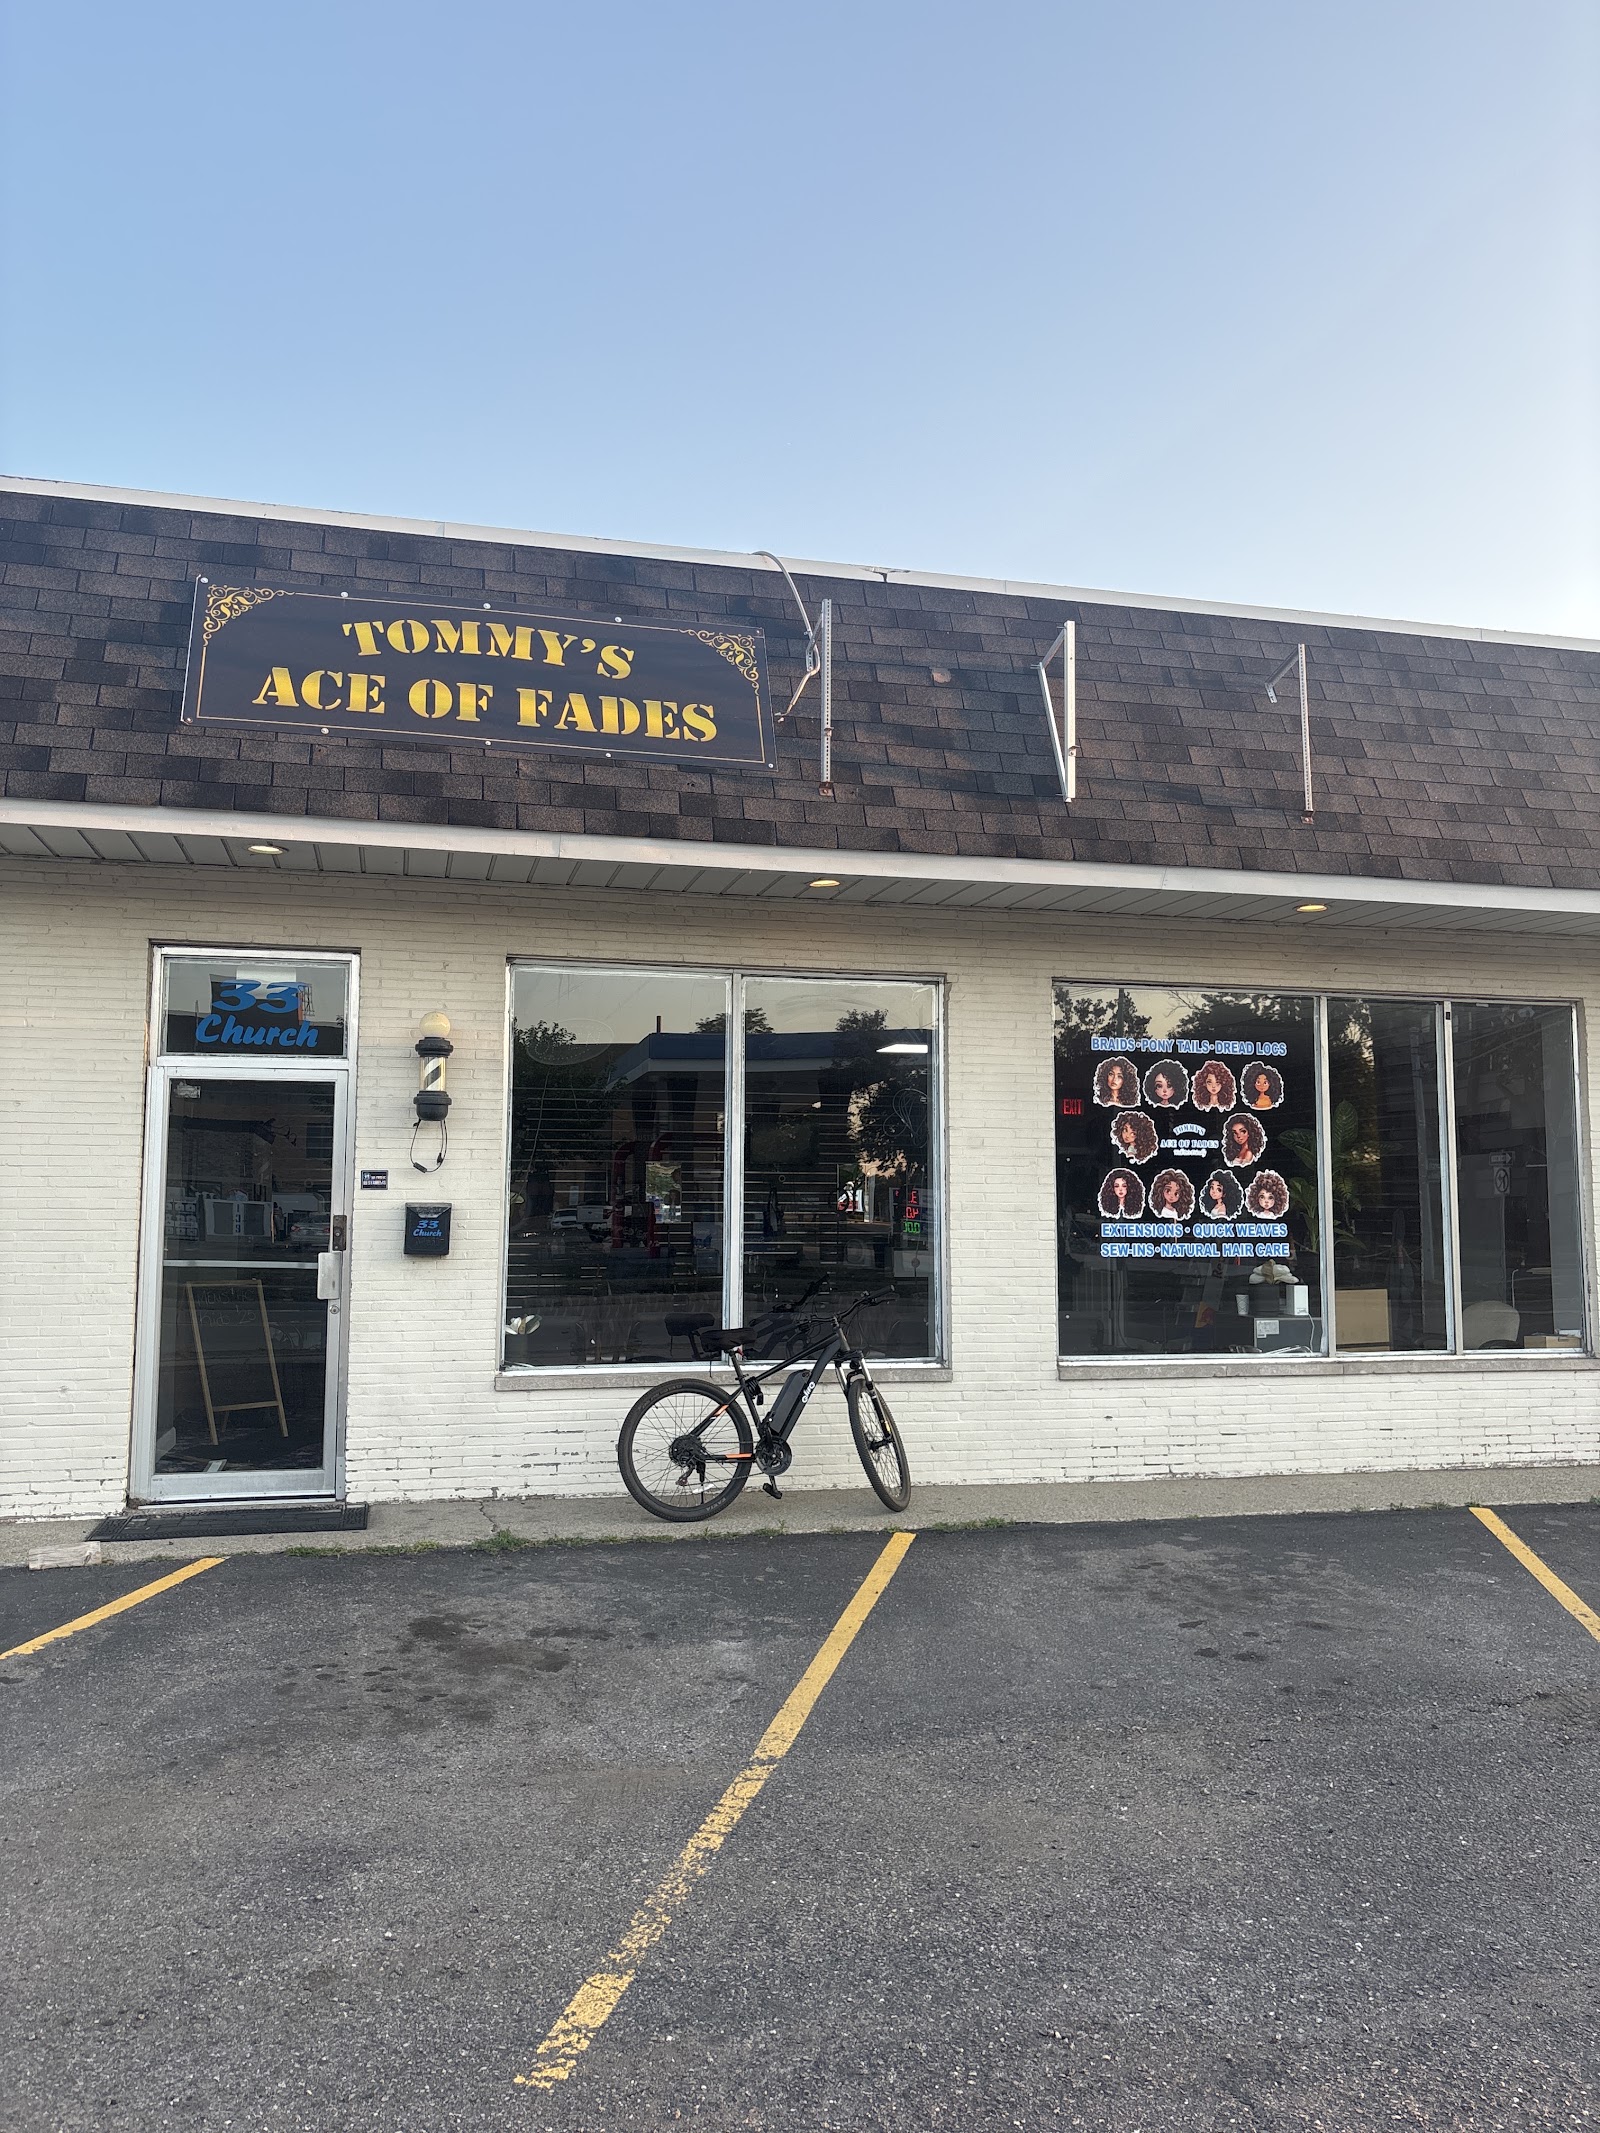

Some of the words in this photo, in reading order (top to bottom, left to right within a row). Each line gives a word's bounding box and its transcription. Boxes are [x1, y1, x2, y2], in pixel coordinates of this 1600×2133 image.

[342, 618, 635, 680] TOMMY'S
[251, 666, 386, 714] ACE
[408, 678, 494, 722] OF
[516, 687, 718, 742] FADES
[212, 979, 306, 1014] 33
[195, 1014, 319, 1048] Church
[1091, 1037, 1136, 1052] BRAIDS
[1141, 1038, 1175, 1053] PONY
[1176, 1039, 1210, 1055] TAILS
[1214, 1040, 1254, 1055] DREAD
[1063, 1098, 1082, 1115] EXIT
[1178, 1139, 1190, 1148] OF
[412, 1229, 442, 1237] Church
[417, 1220, 439, 1229] 33
[1101, 1223, 1183, 1238] EXTENSIONS
[1193, 1223, 1235, 1238] QUICK
[1236, 1223, 1288, 1238] WEAVES
[1100, 1242, 1155, 1257] SEW-INS
[1160, 1242, 1220, 1257] NATURAL
[1222, 1242, 1255, 1258] HAIR
[1255, 1242, 1290, 1258] CARE
